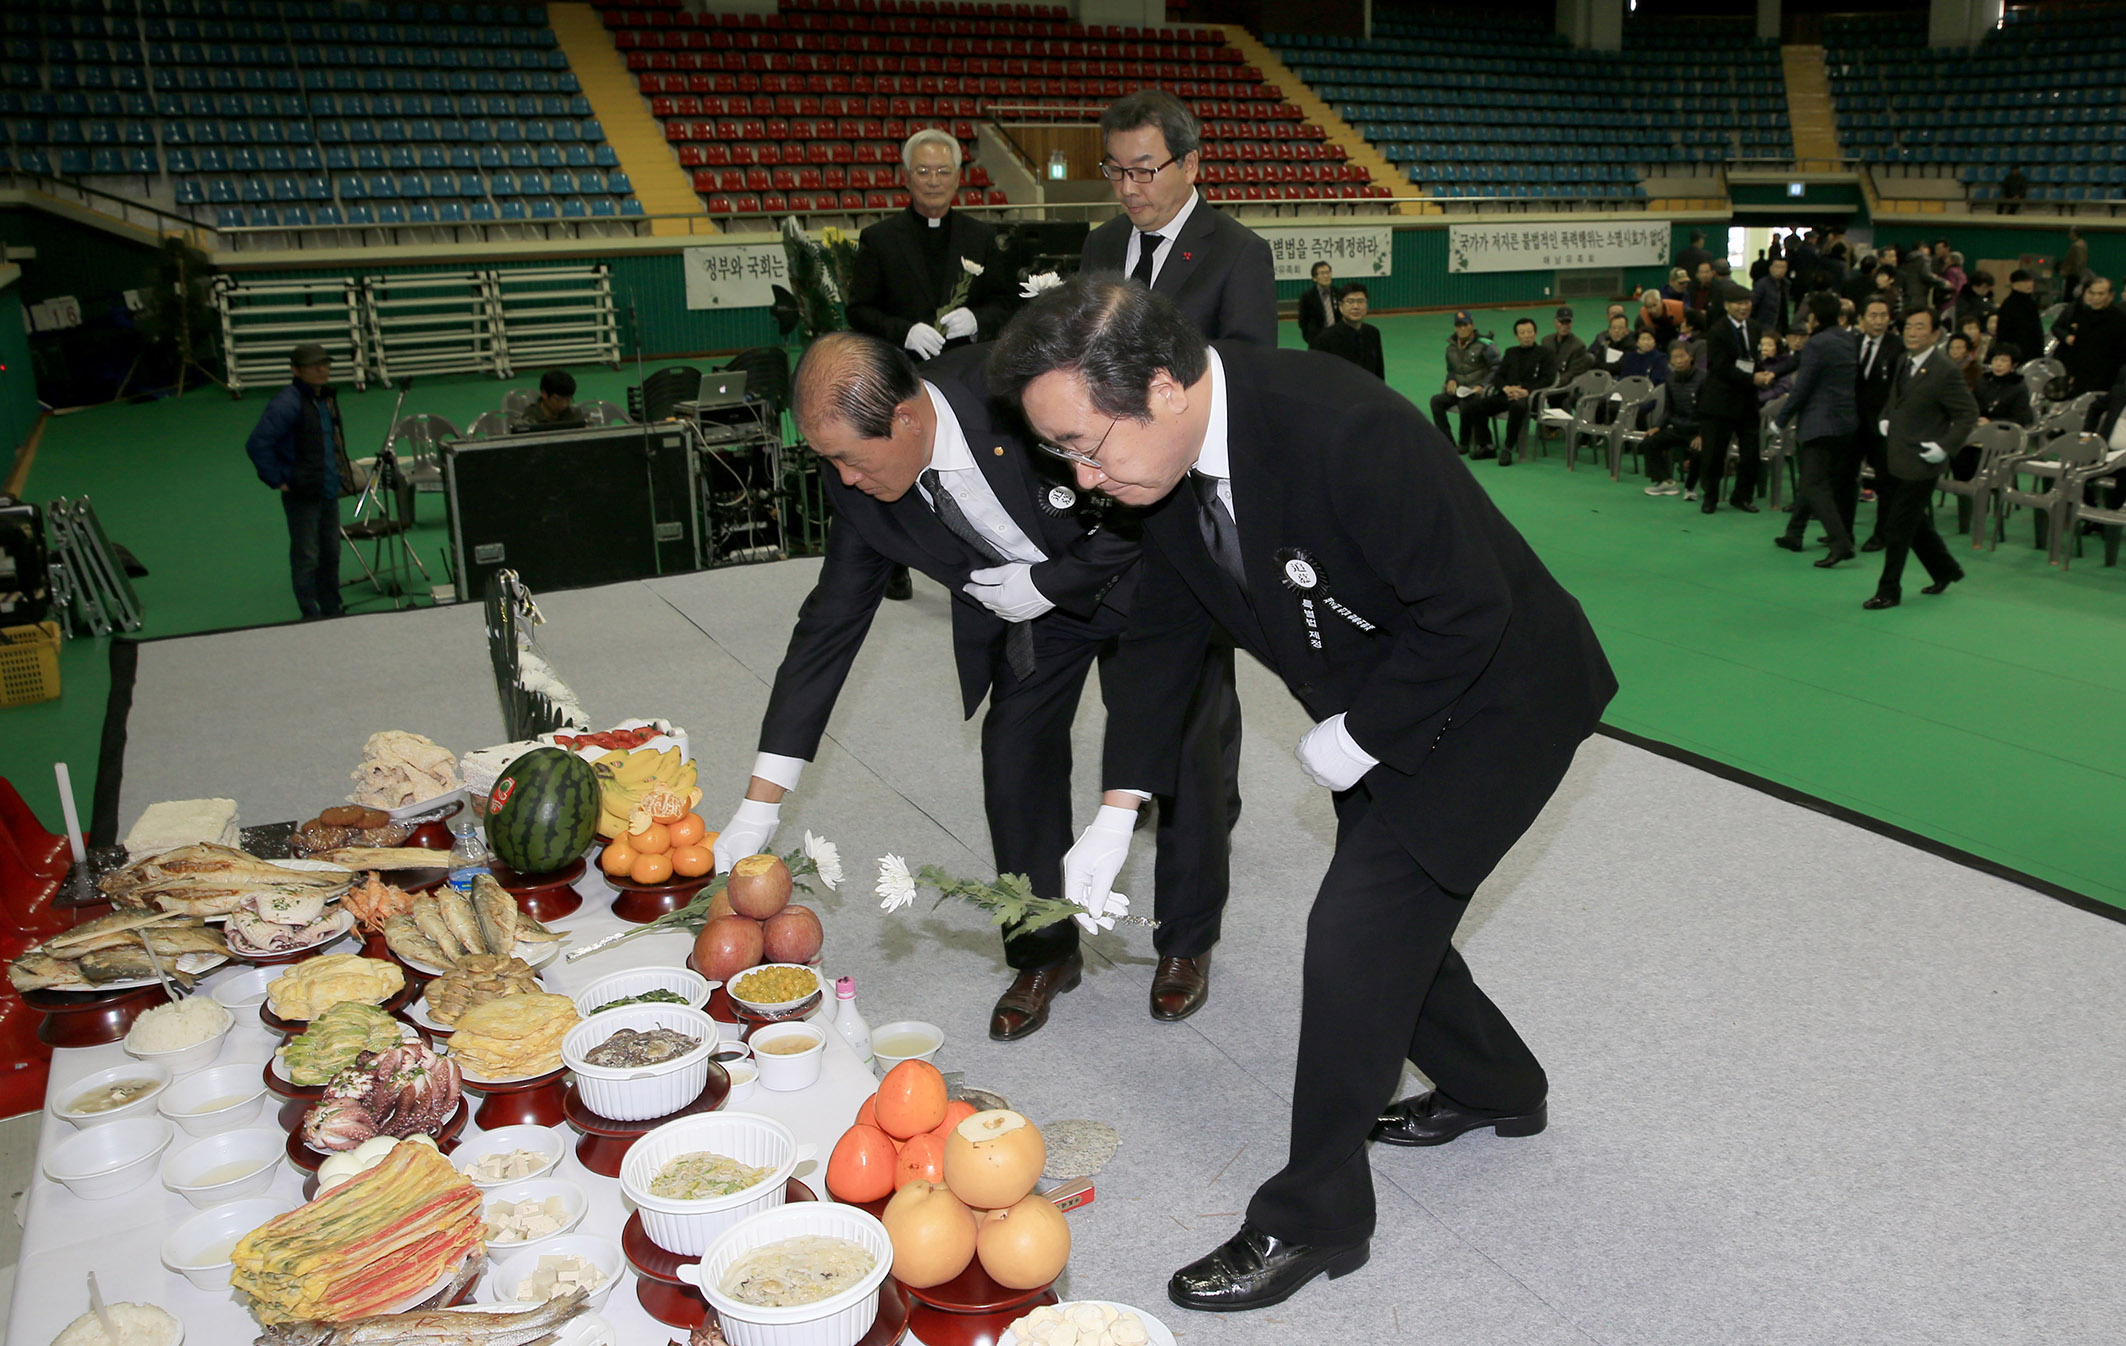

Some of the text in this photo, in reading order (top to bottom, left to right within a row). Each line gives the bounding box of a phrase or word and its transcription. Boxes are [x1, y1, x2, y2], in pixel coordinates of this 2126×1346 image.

[1270, 237, 1308, 261] 별법을
[1459, 232, 1488, 253] 국가가
[1492, 231, 1520, 252] 저지른
[1522, 230, 1559, 251] 불법적인
[705, 253, 785, 282] 정부와 국회는
